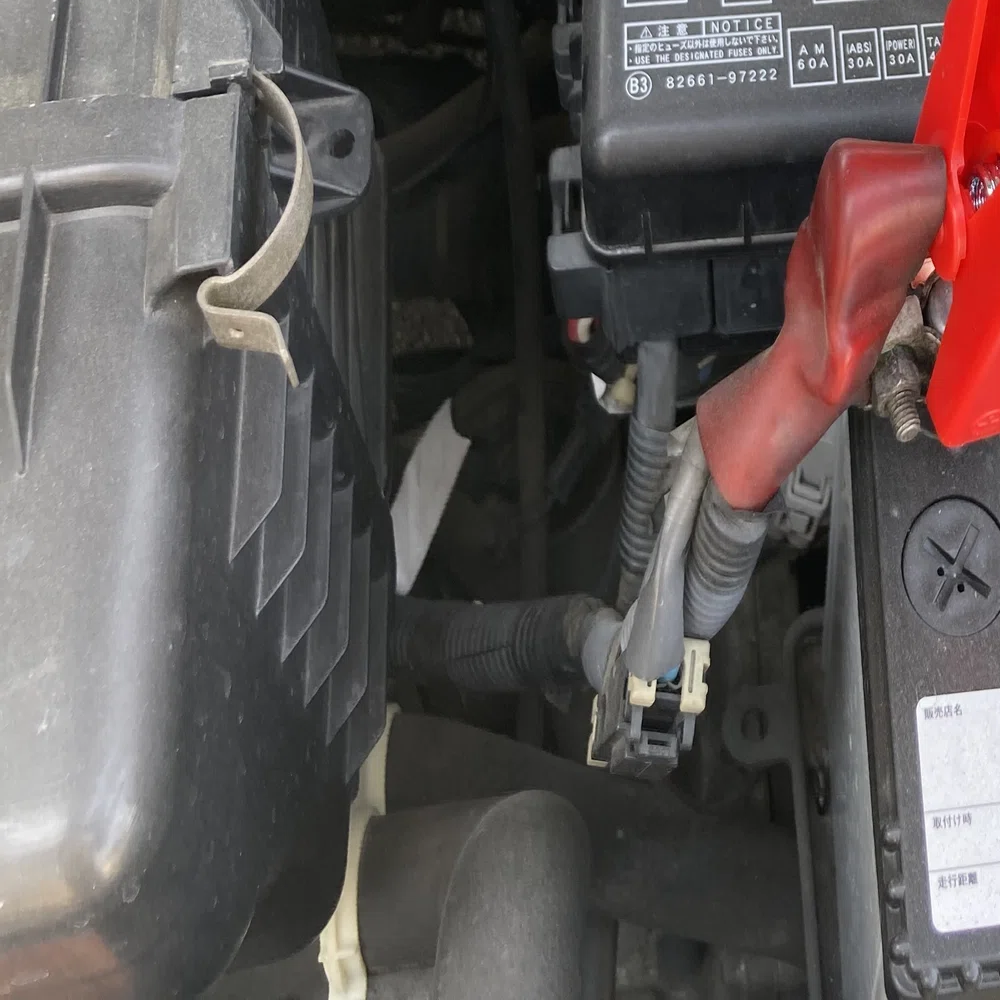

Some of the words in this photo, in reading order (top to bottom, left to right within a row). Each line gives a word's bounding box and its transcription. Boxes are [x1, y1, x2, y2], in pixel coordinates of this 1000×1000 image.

[658, 23, 689, 38] 注意
[711, 17, 774, 33] NOTICE
[847, 41, 872, 54] (ABS)
[886, 38, 916, 51] (POWER)
[926, 36, 941, 48] TA
[635, 56, 651, 65] USE
[655, 54, 671, 63] THE
[674, 50, 724, 62] DESIGNATED
[728, 47, 753, 58] FUSES
[757, 46, 779, 55] ONLY.
[848, 56, 874, 69] 30A
[889, 53, 916, 66] 30A
[798, 58, 829, 71] 60A
[629, 77, 649, 94] B3
[666, 68, 778, 89] 82661-97222
[924, 703, 963, 721] 販売店名
[933, 813, 973, 829] 取付け時
[938, 872, 978, 889] 走行距離
